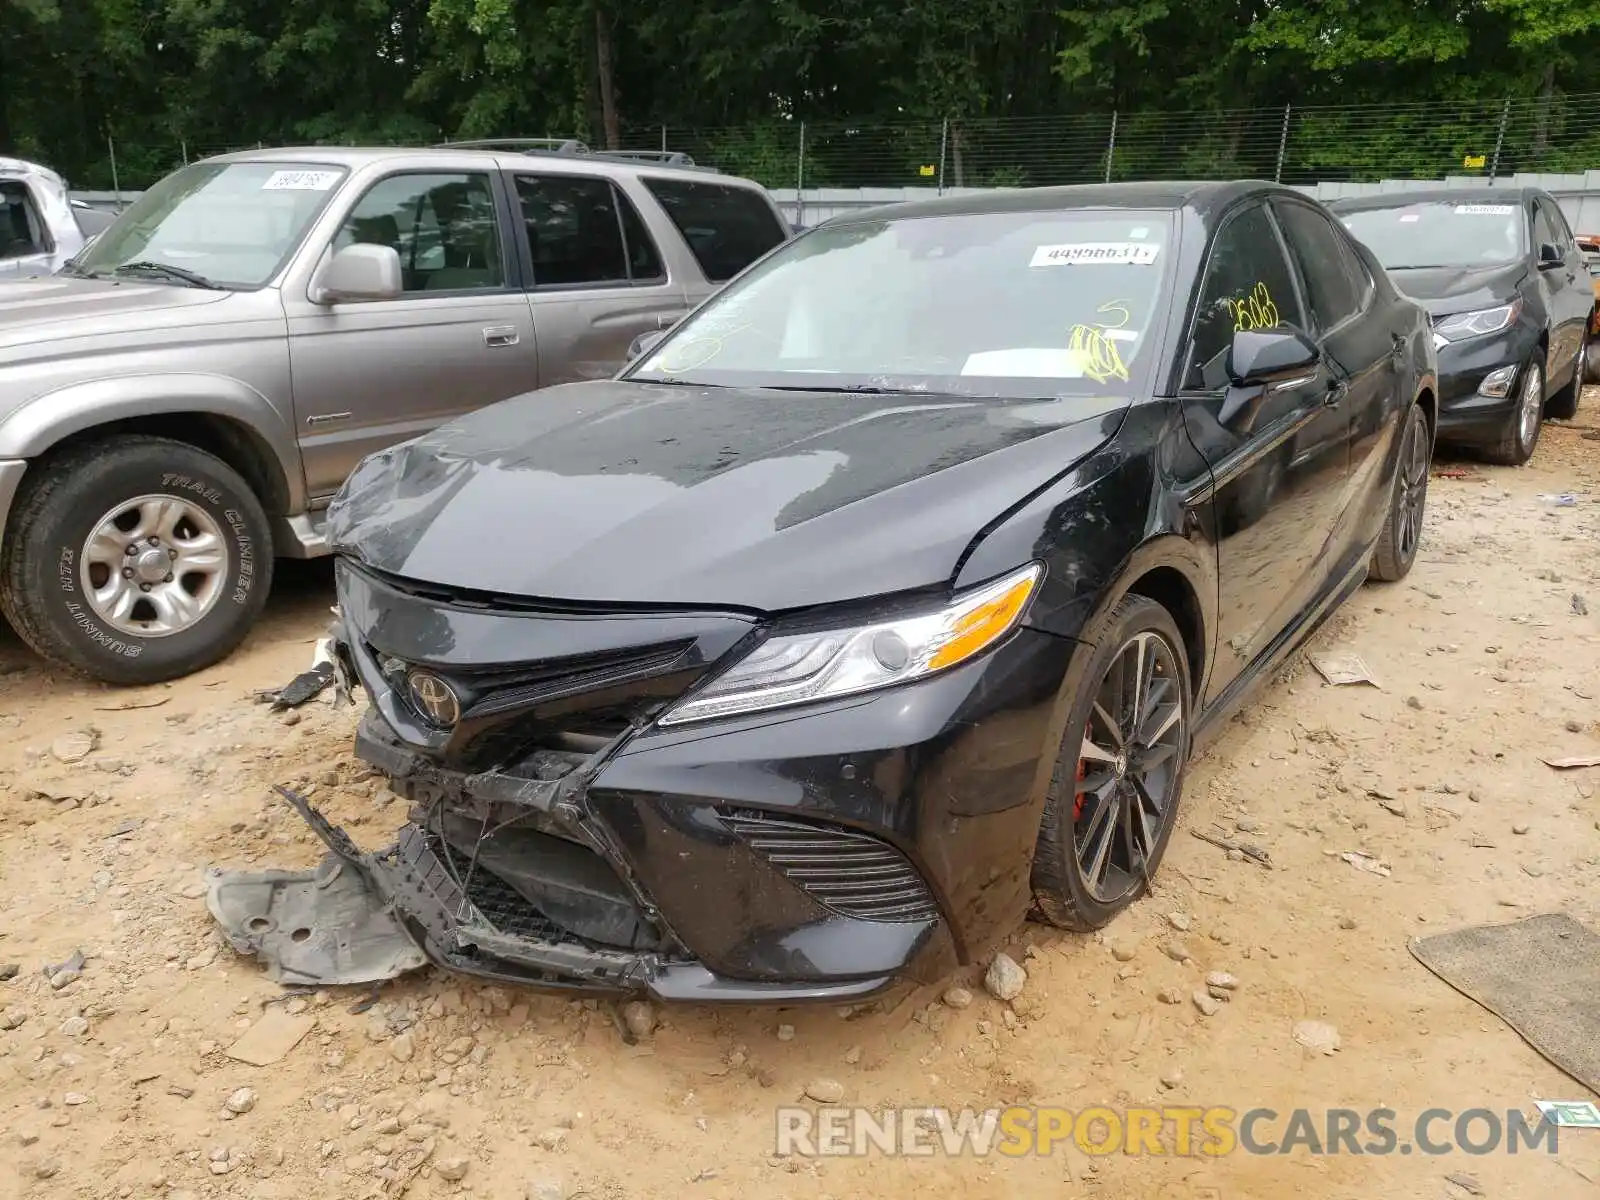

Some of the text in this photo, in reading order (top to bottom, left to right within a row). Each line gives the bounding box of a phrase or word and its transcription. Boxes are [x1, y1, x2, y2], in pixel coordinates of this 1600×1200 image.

[160, 473, 254, 605] TRAIL CLIMBER
[65, 601, 143, 658] SUMMIT
